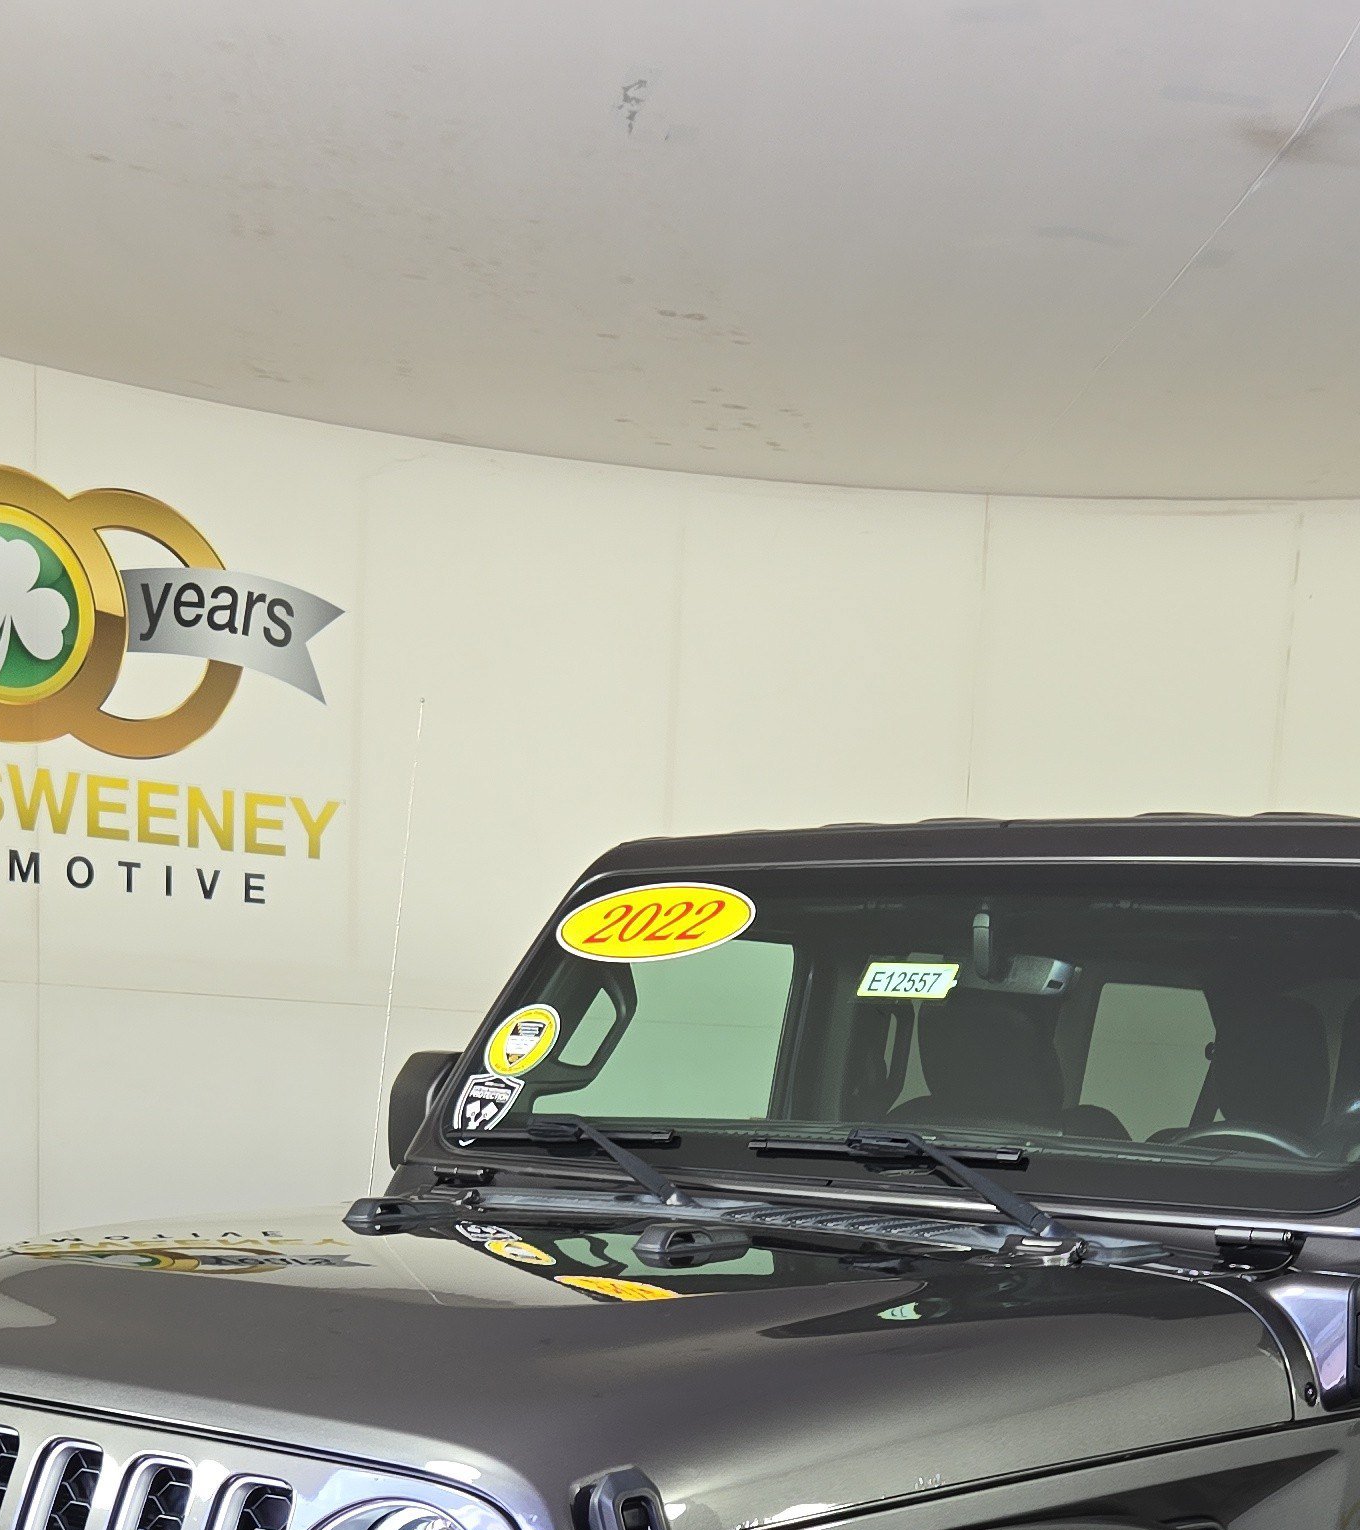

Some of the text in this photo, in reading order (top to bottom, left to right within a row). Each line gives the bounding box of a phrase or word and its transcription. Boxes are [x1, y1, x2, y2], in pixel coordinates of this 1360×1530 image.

[140, 579, 295, 649] years
[581, 899, 726, 944] 2022
[867, 971, 943, 993] E12557
